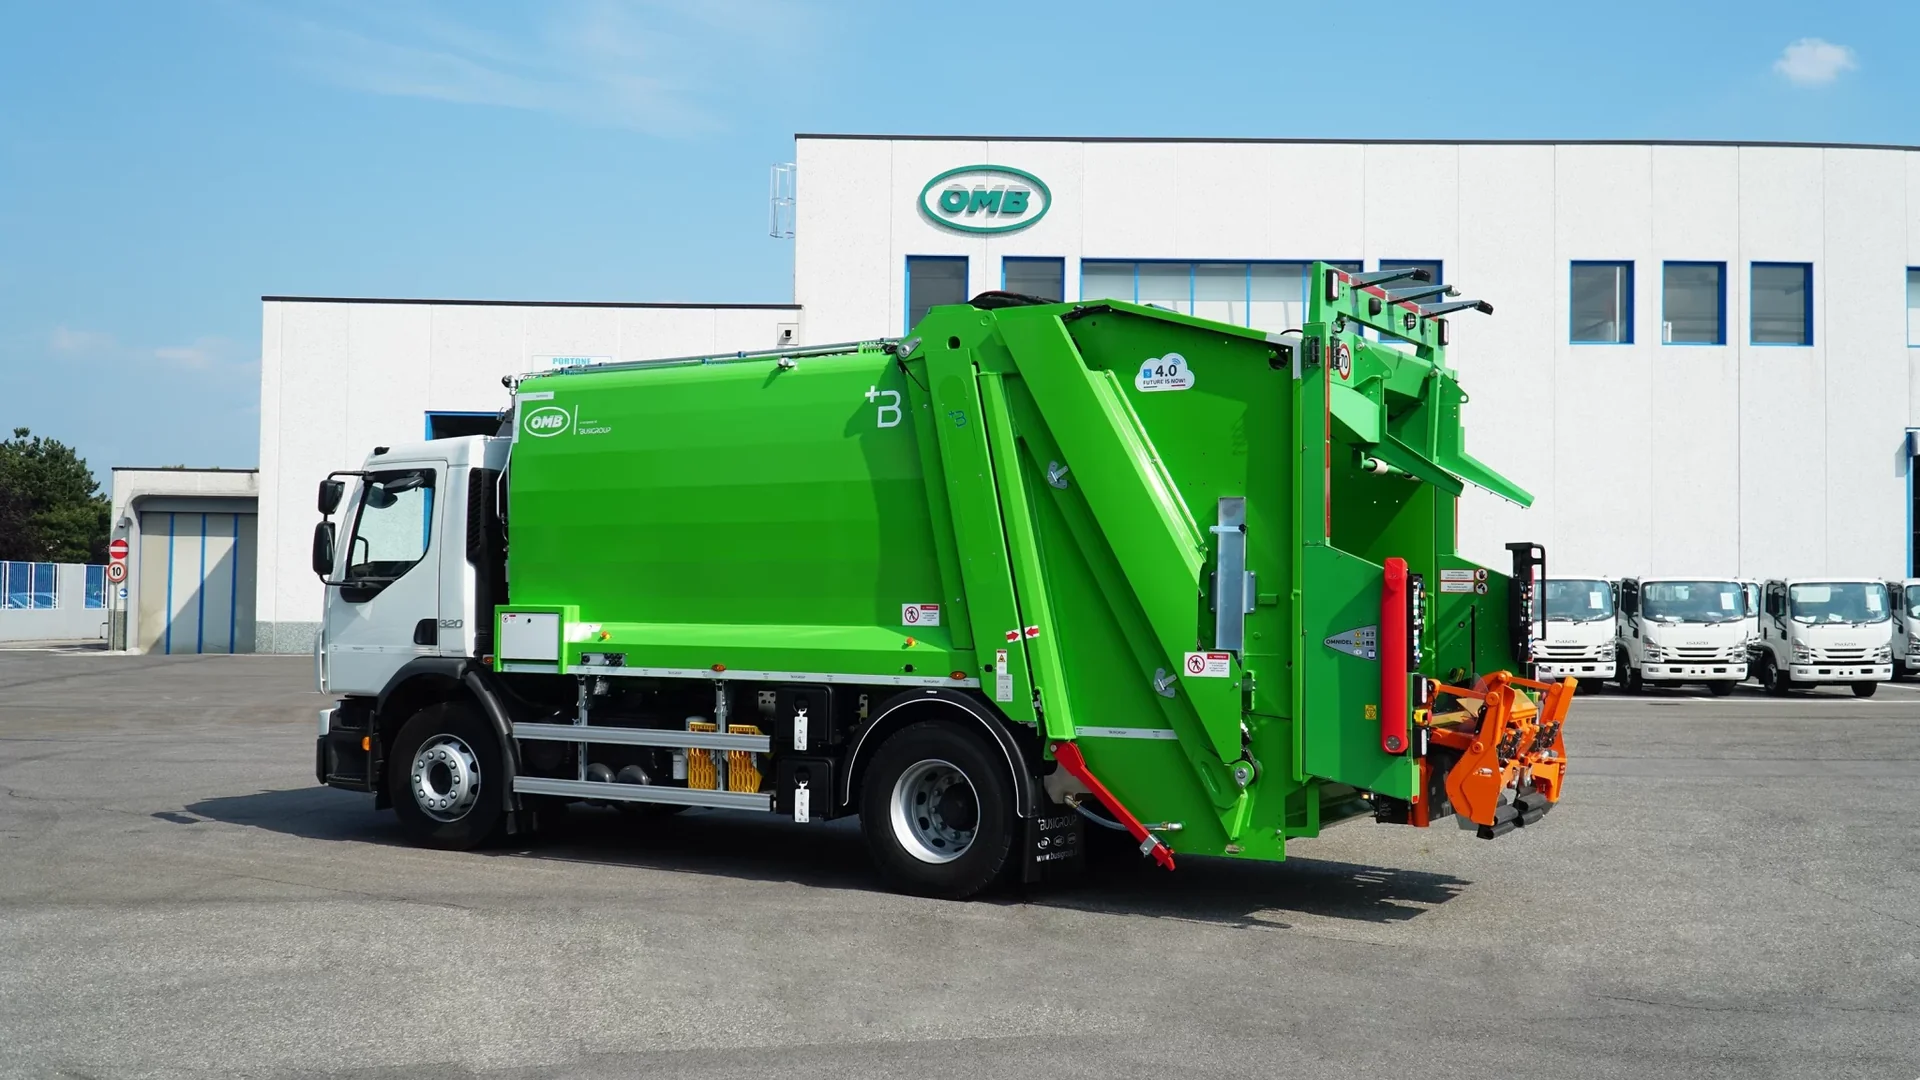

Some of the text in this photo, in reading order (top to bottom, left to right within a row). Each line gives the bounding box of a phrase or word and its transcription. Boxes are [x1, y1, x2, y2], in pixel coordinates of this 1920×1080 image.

[940, 184, 1031, 213] OMB
[1155, 364, 1177, 377] 4.0
[531, 415, 563, 428] OMB
[112, 566, 121, 576] 10
[439, 619, 463, 628] 320
